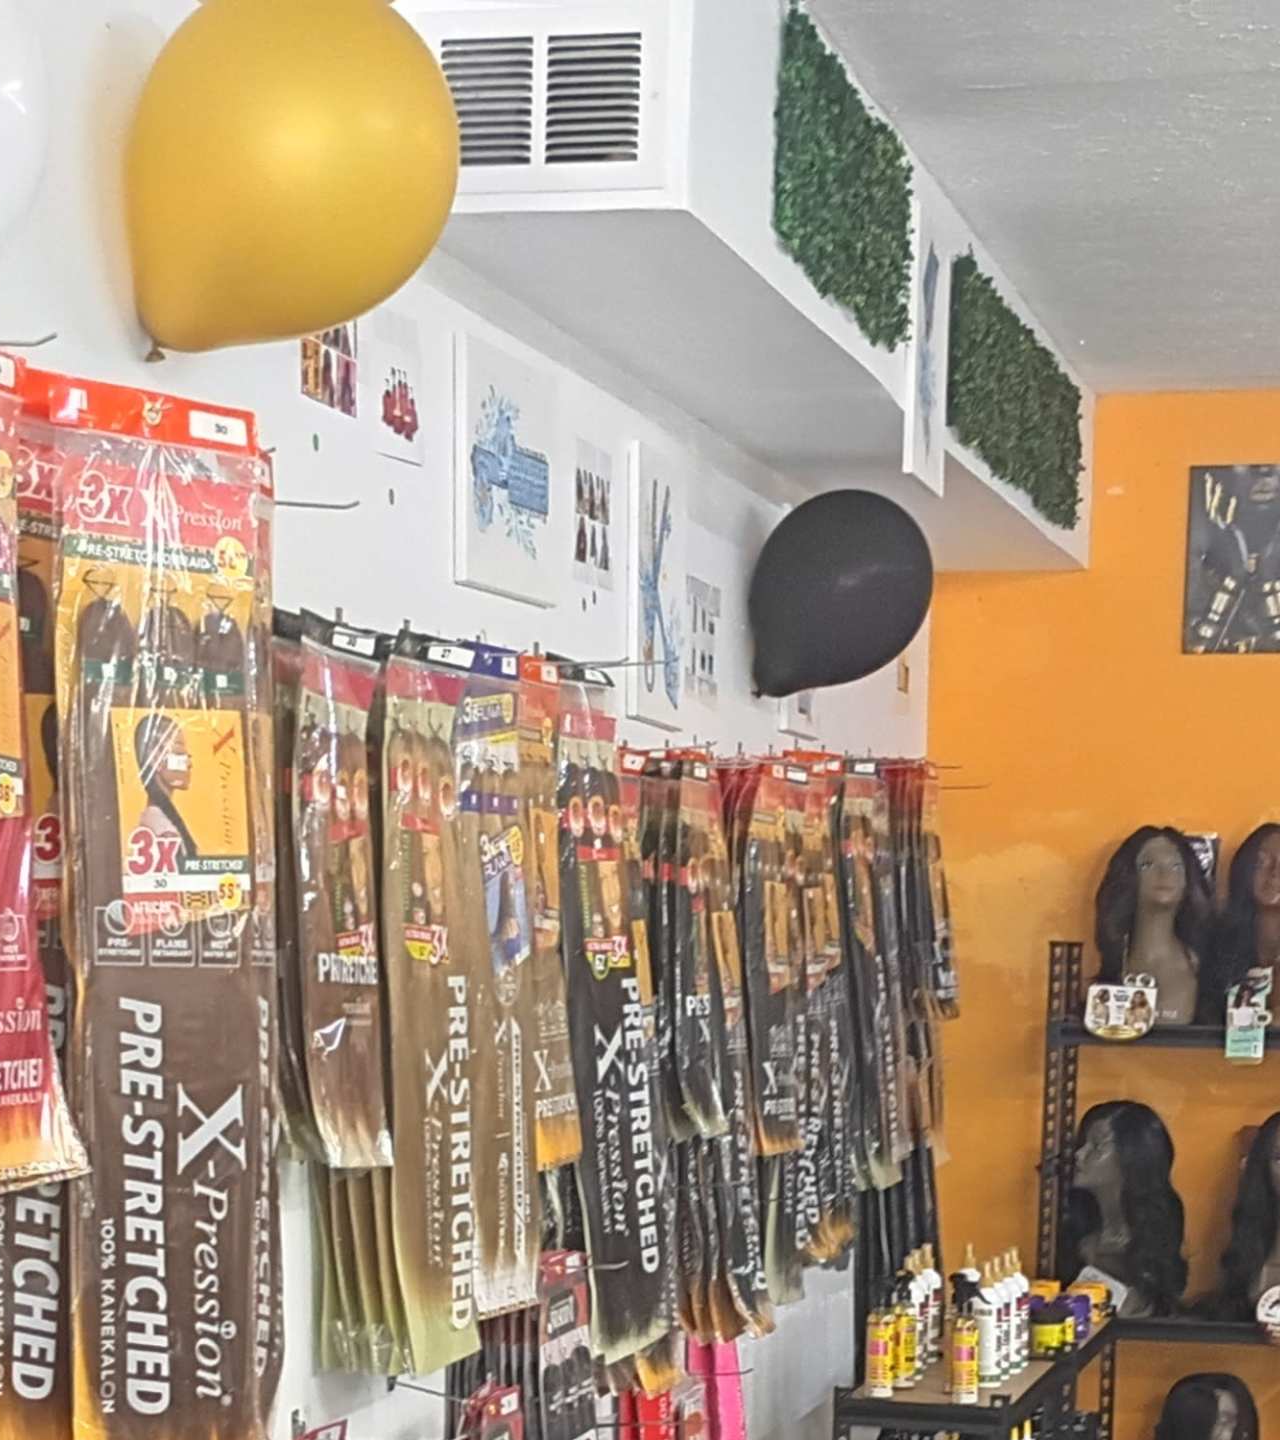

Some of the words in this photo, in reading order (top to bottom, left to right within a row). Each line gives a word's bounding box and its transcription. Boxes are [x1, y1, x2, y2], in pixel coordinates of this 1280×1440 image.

[100, 1217, 117, 1269] 100%
[120, 995, 171, 1416] PRE-STRETCHED
[175, 1082, 249, 1399] X-Pression
[447, 974, 473, 1331] PRE-STRETCHED
[620, 976, 661, 1275] PRE-STRETCHED
[99, 1277, 117, 1415] KANEKALON
